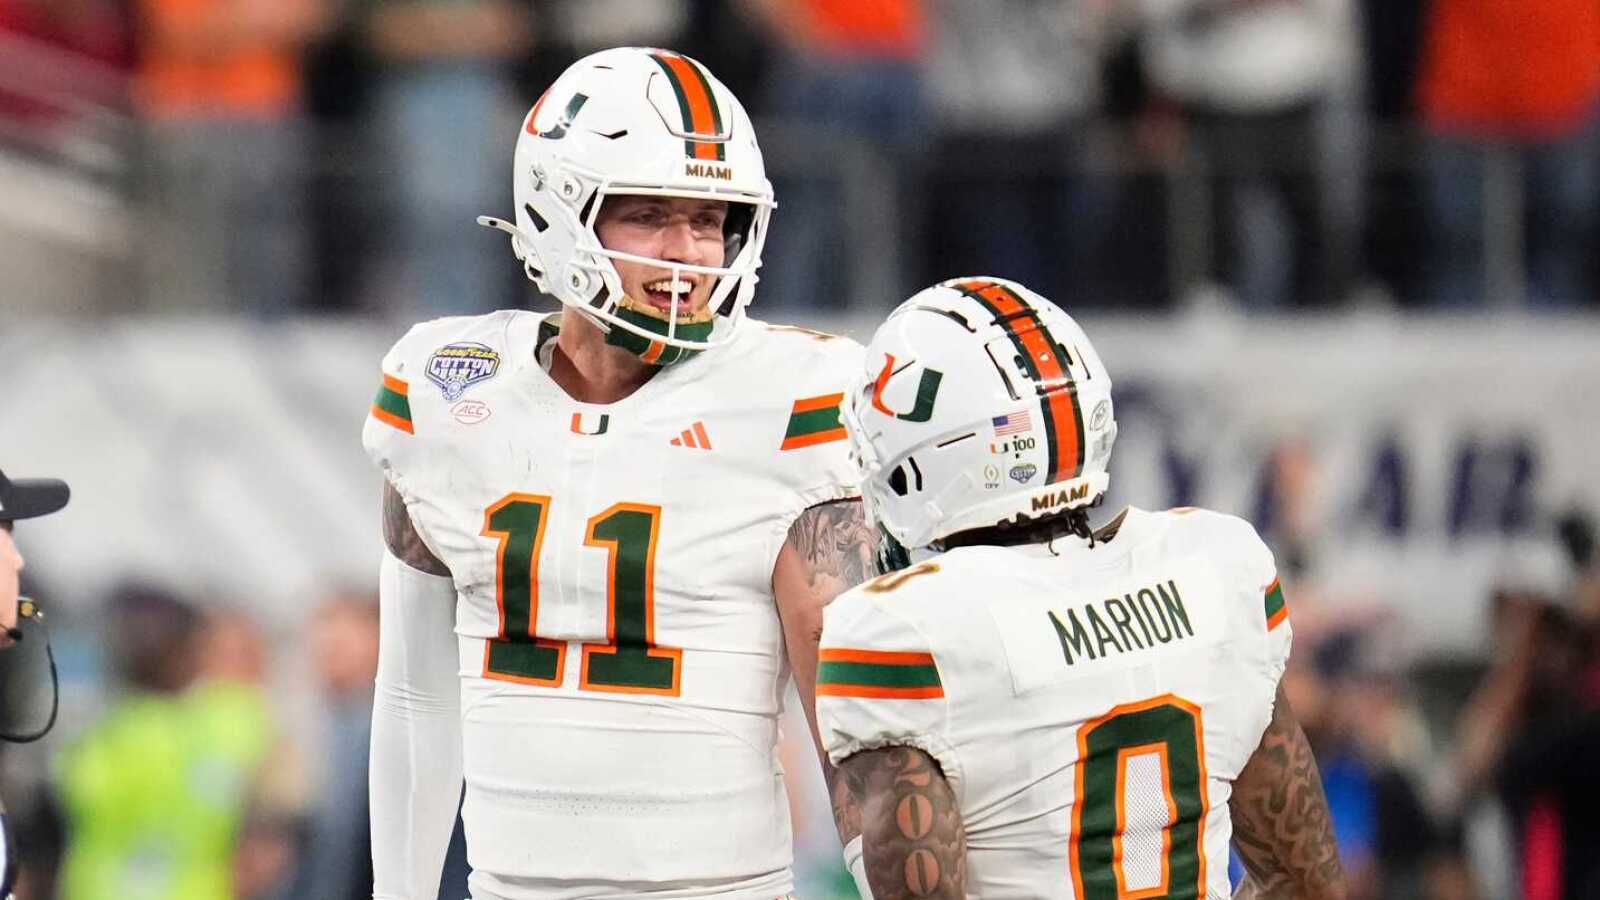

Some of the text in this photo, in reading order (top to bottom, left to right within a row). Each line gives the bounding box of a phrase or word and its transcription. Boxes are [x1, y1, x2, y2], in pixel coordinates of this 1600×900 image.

[686, 163, 732, 181] MIAMI
[457, 404, 485, 416] ACC
[570, 412, 610, 436] U
[1031, 483, 1088, 511] MIAMI
[479, 491, 683, 697] 11
[1047, 579, 1195, 666] MARION
[1069, 692, 1209, 900] 0
